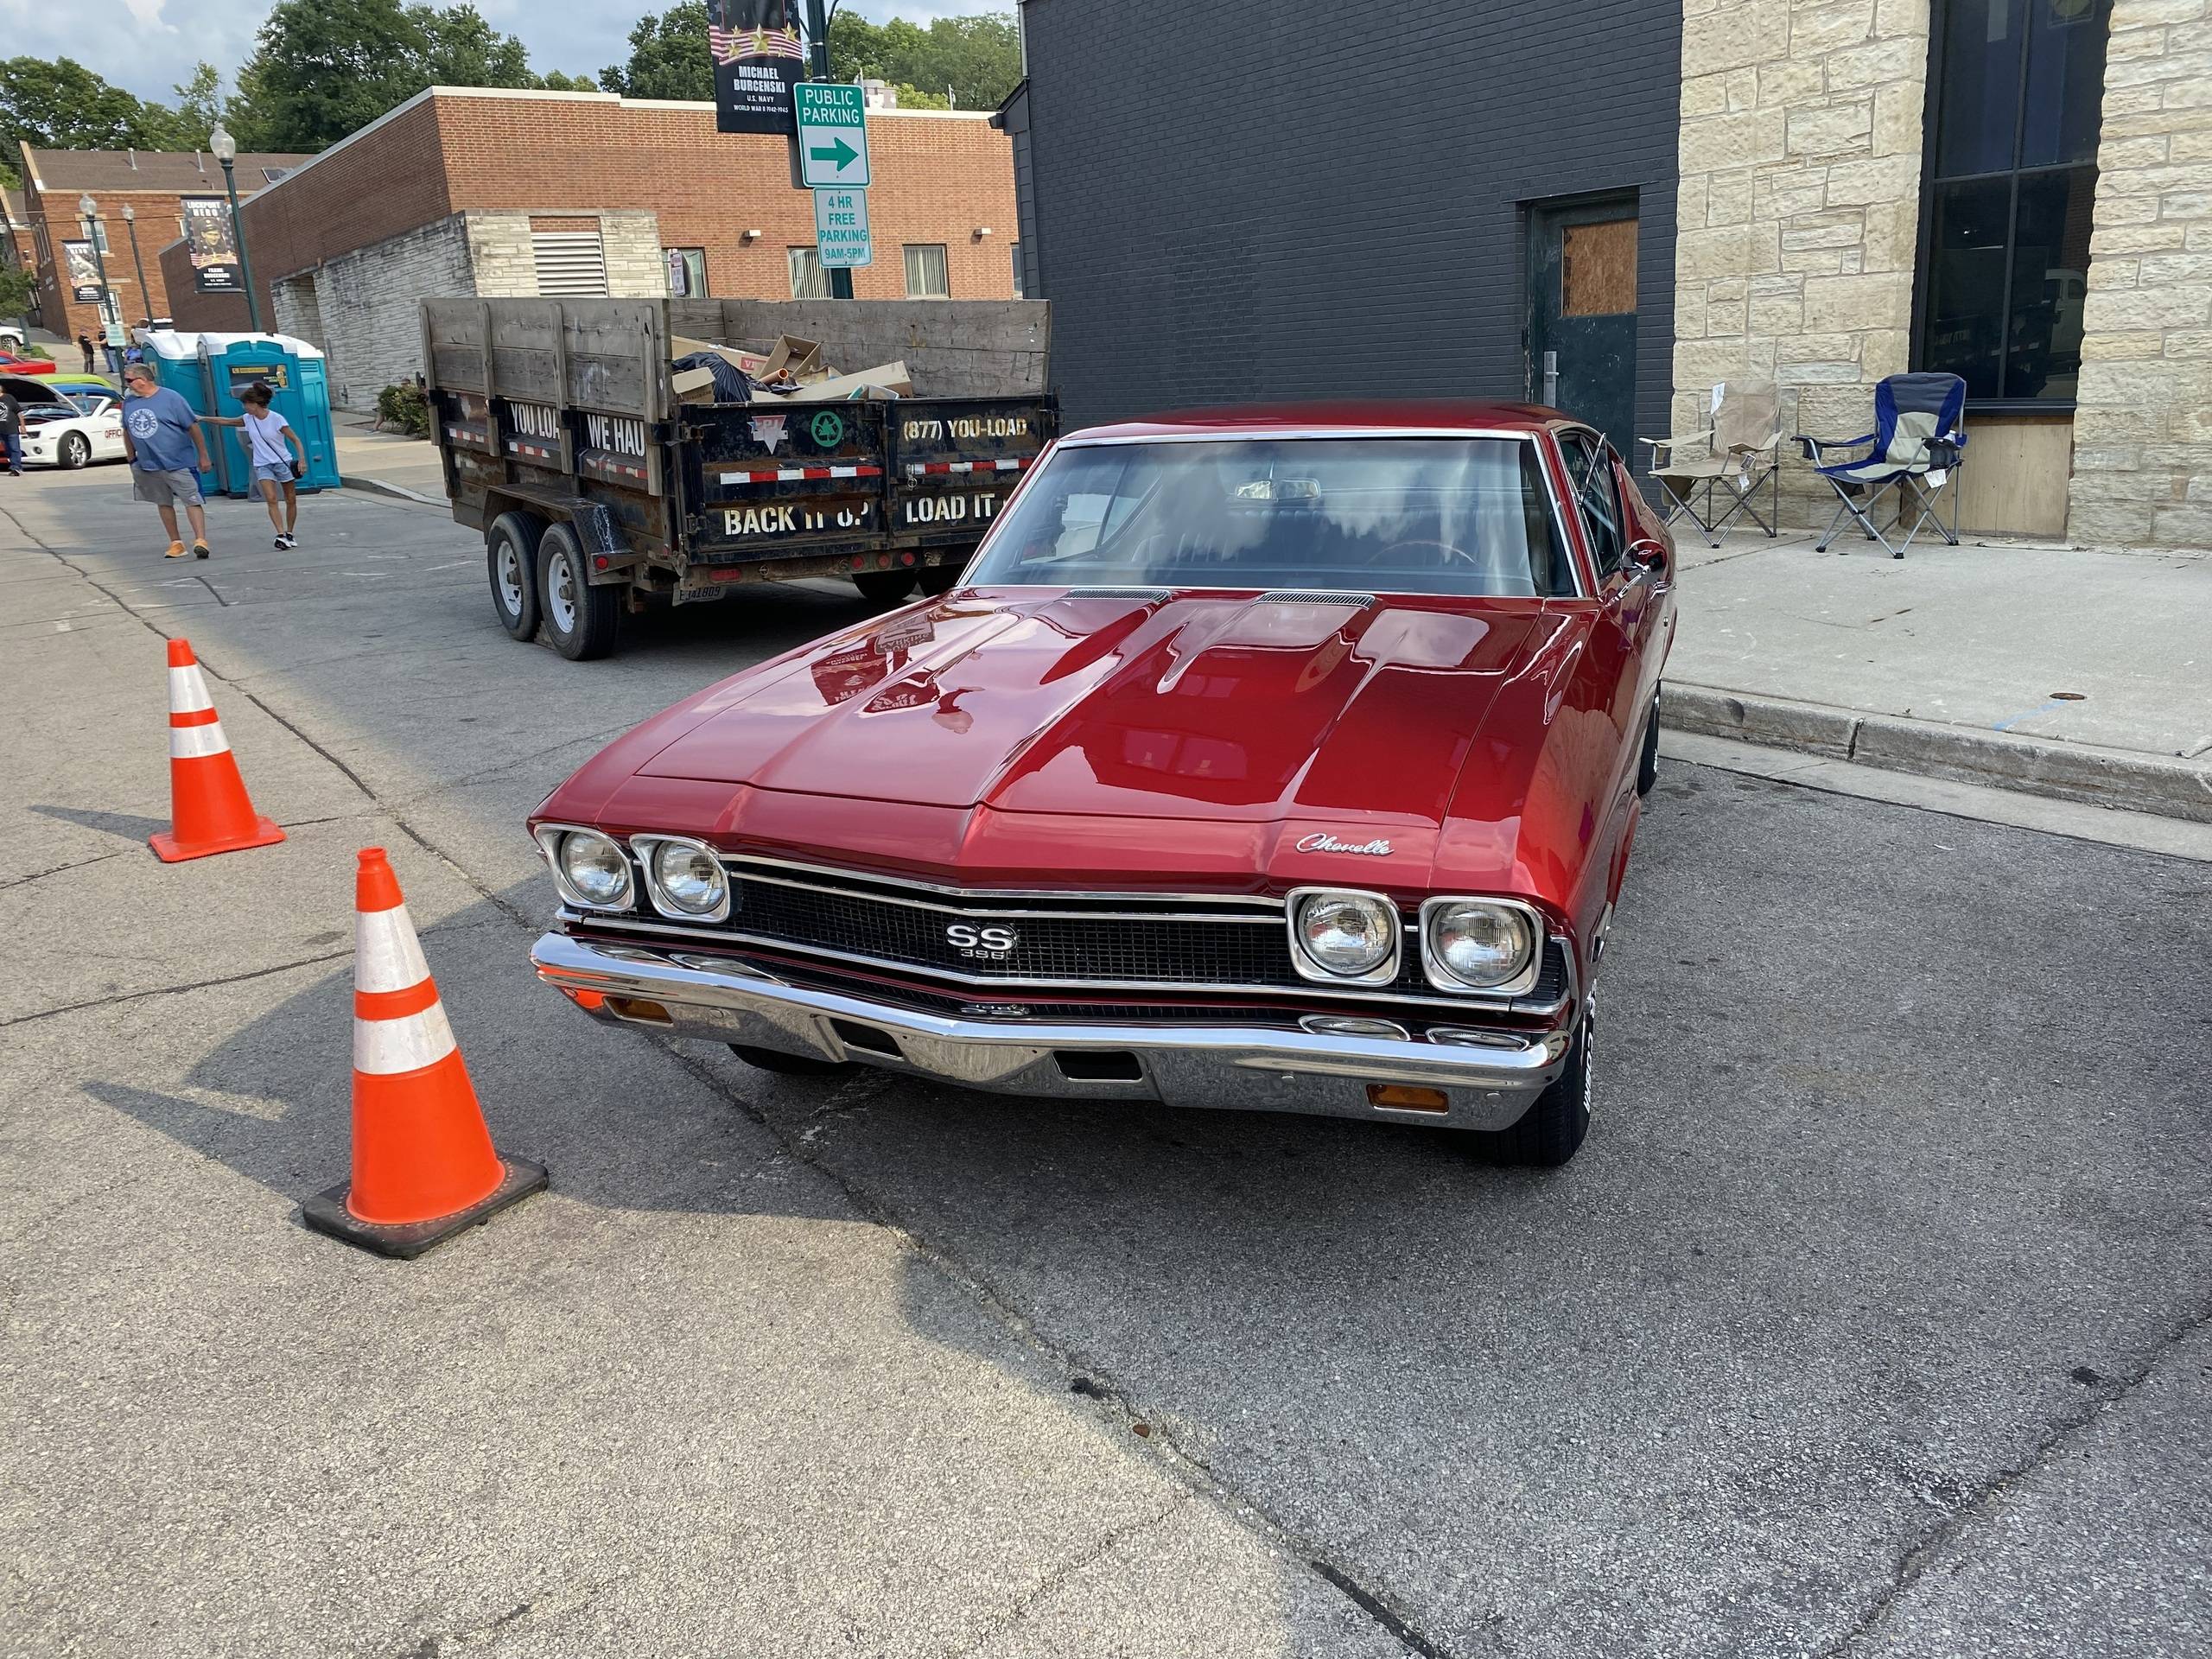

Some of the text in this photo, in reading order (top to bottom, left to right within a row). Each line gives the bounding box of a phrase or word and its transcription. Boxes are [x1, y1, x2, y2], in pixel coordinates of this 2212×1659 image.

[738, 65, 779, 79] MICHAEL
[805, 89, 854, 106] PUBLIC
[803, 107, 860, 124] PARKING
[828, 196, 853, 209] 4 HR
[828, 213, 855, 226] FREE
[820, 229, 867, 243] PARKING
[825, 248, 866, 259] 9AM-5PM
[510, 403, 561, 439] YOU LOA
[903, 418, 1028, 441] (877) YOU-LOAD
[587, 414, 646, 457] WE HAU
[906, 493, 995, 523] LOAD IT
[725, 505, 796, 536] BACK
[1296, 833, 1395, 856] Chevelle
[947, 925, 1014, 950] SS
[961, 949, 1004, 960] 396
